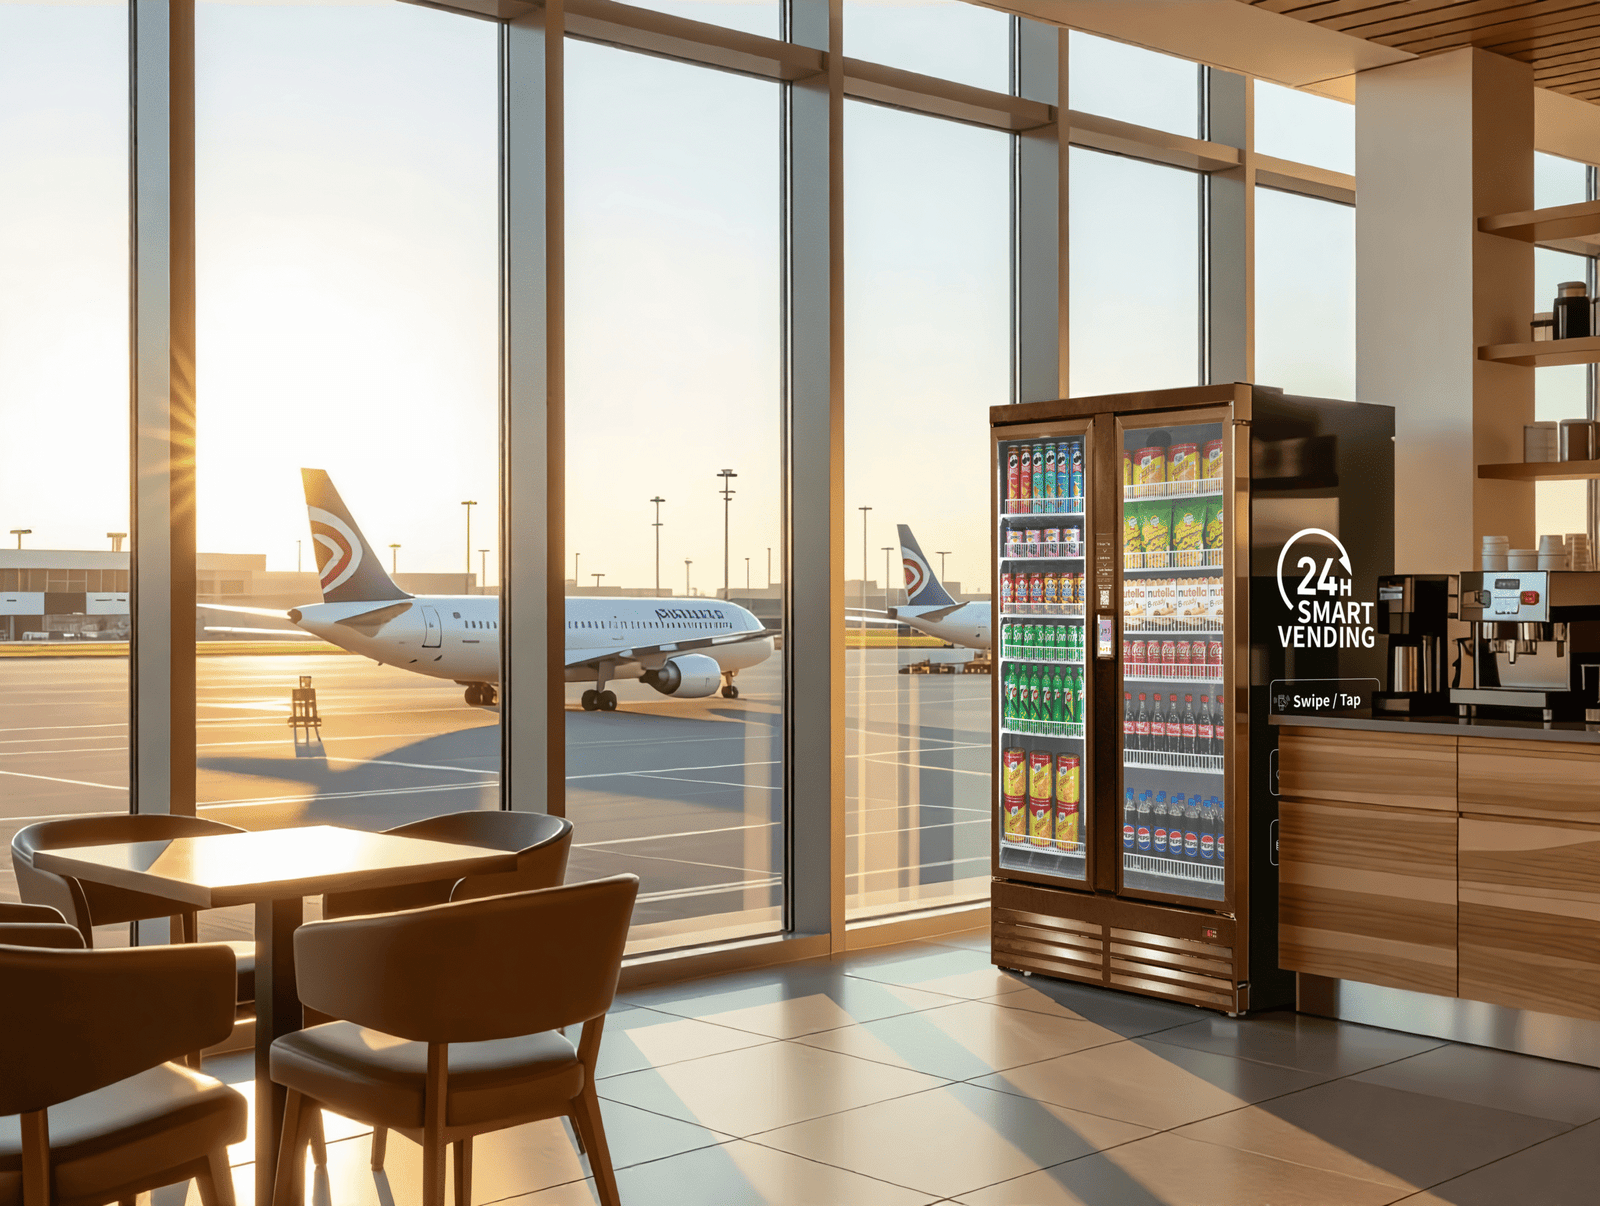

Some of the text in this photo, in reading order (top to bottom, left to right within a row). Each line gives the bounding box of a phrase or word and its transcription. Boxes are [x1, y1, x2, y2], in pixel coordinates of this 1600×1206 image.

[1297, 556, 1352, 597] 24H
[1123, 588, 1145, 598] utella
[1147, 587, 1176, 598] nutella
[1178, 586, 1207, 598] nutella
[1297, 600, 1375, 625] SMART
[1277, 625, 1375, 648] VENDING
[1293, 693, 1361, 710] Swipe / Tap
